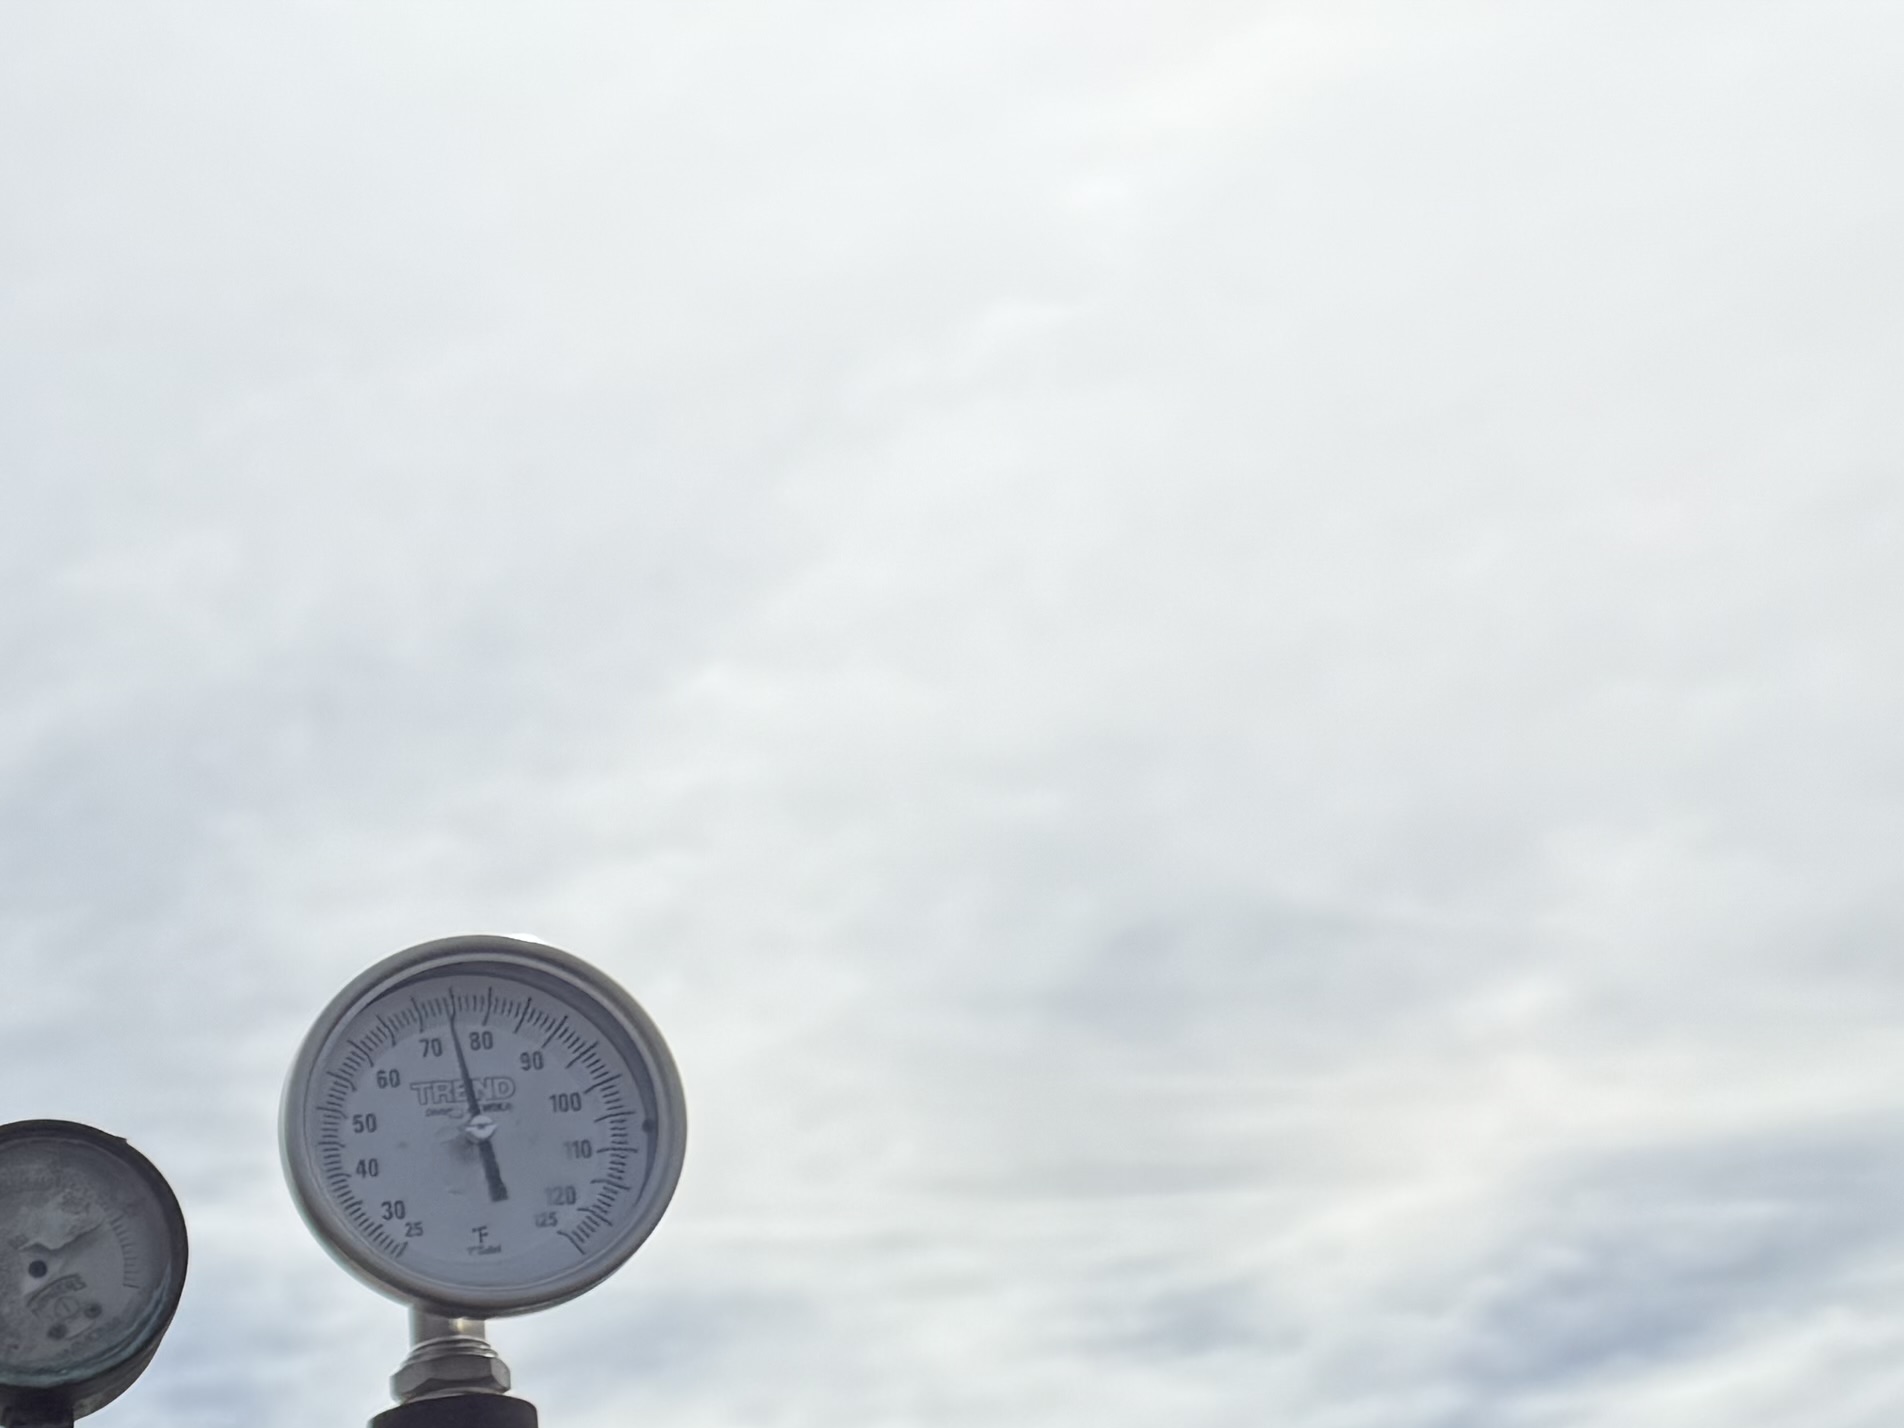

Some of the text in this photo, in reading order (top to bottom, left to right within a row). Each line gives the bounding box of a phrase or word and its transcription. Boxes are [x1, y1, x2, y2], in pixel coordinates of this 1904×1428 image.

[419, 1038, 442, 1057] 70
[469, 1031, 493, 1051] 80
[520, 1052, 544, 1071] 90
[376, 1069, 400, 1088] 60
[410, 1076, 516, 1105] TREND
[549, 1092, 582, 1112] 100
[352, 1114, 377, 1133] 50
[565, 1140, 592, 1159] 110
[356, 1159, 379, 1178] 40
[545, 1186, 576, 1205] 120
[381, 1200, 405, 1221] 30
[405, 1222, 423, 1238] 25
